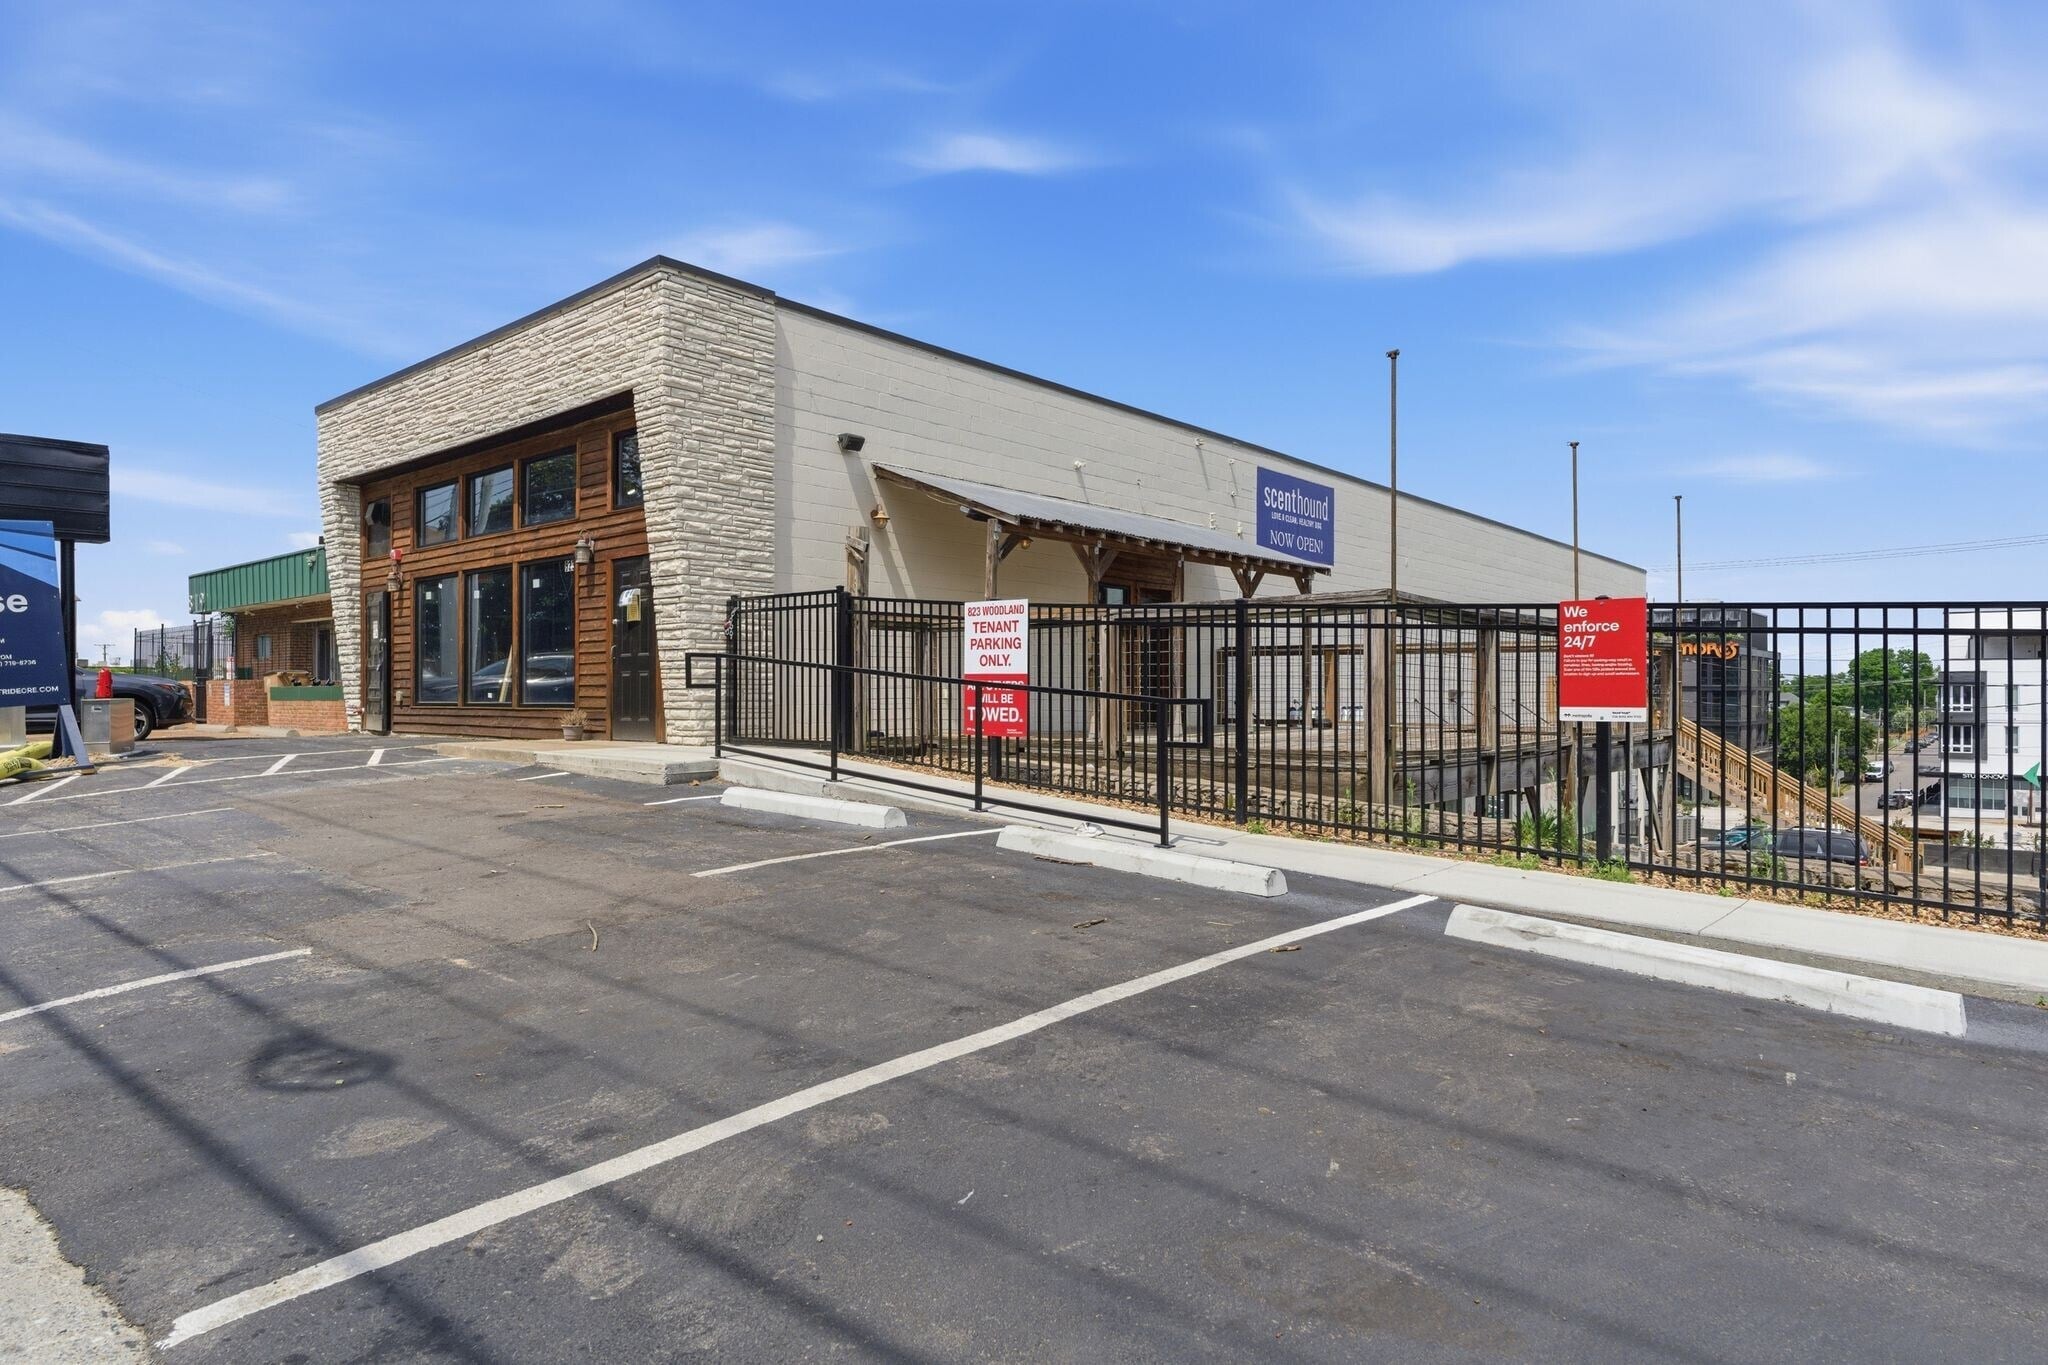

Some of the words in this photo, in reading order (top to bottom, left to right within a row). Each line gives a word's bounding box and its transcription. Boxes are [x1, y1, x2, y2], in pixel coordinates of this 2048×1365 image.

[1264, 487, 1328, 520] scenthound
[1270, 529, 1295, 549] NOW
[1296, 535, 1323, 554] OPEN!
[0, 594, 28, 613] e
[967, 606, 981, 616] 823
[982, 604, 1025, 616] WOODLAND
[1563, 606, 1588, 618] We
[972, 620, 1019, 634] TENANT
[1563, 620, 1620, 633] enforce
[970, 637, 1022, 650] PARKING
[1563, 635, 1596, 650] 24/7
[979, 654, 1011, 667] ONLY.
[982, 693, 999, 704] ILL
[1001, 693, 1014, 704] BE
